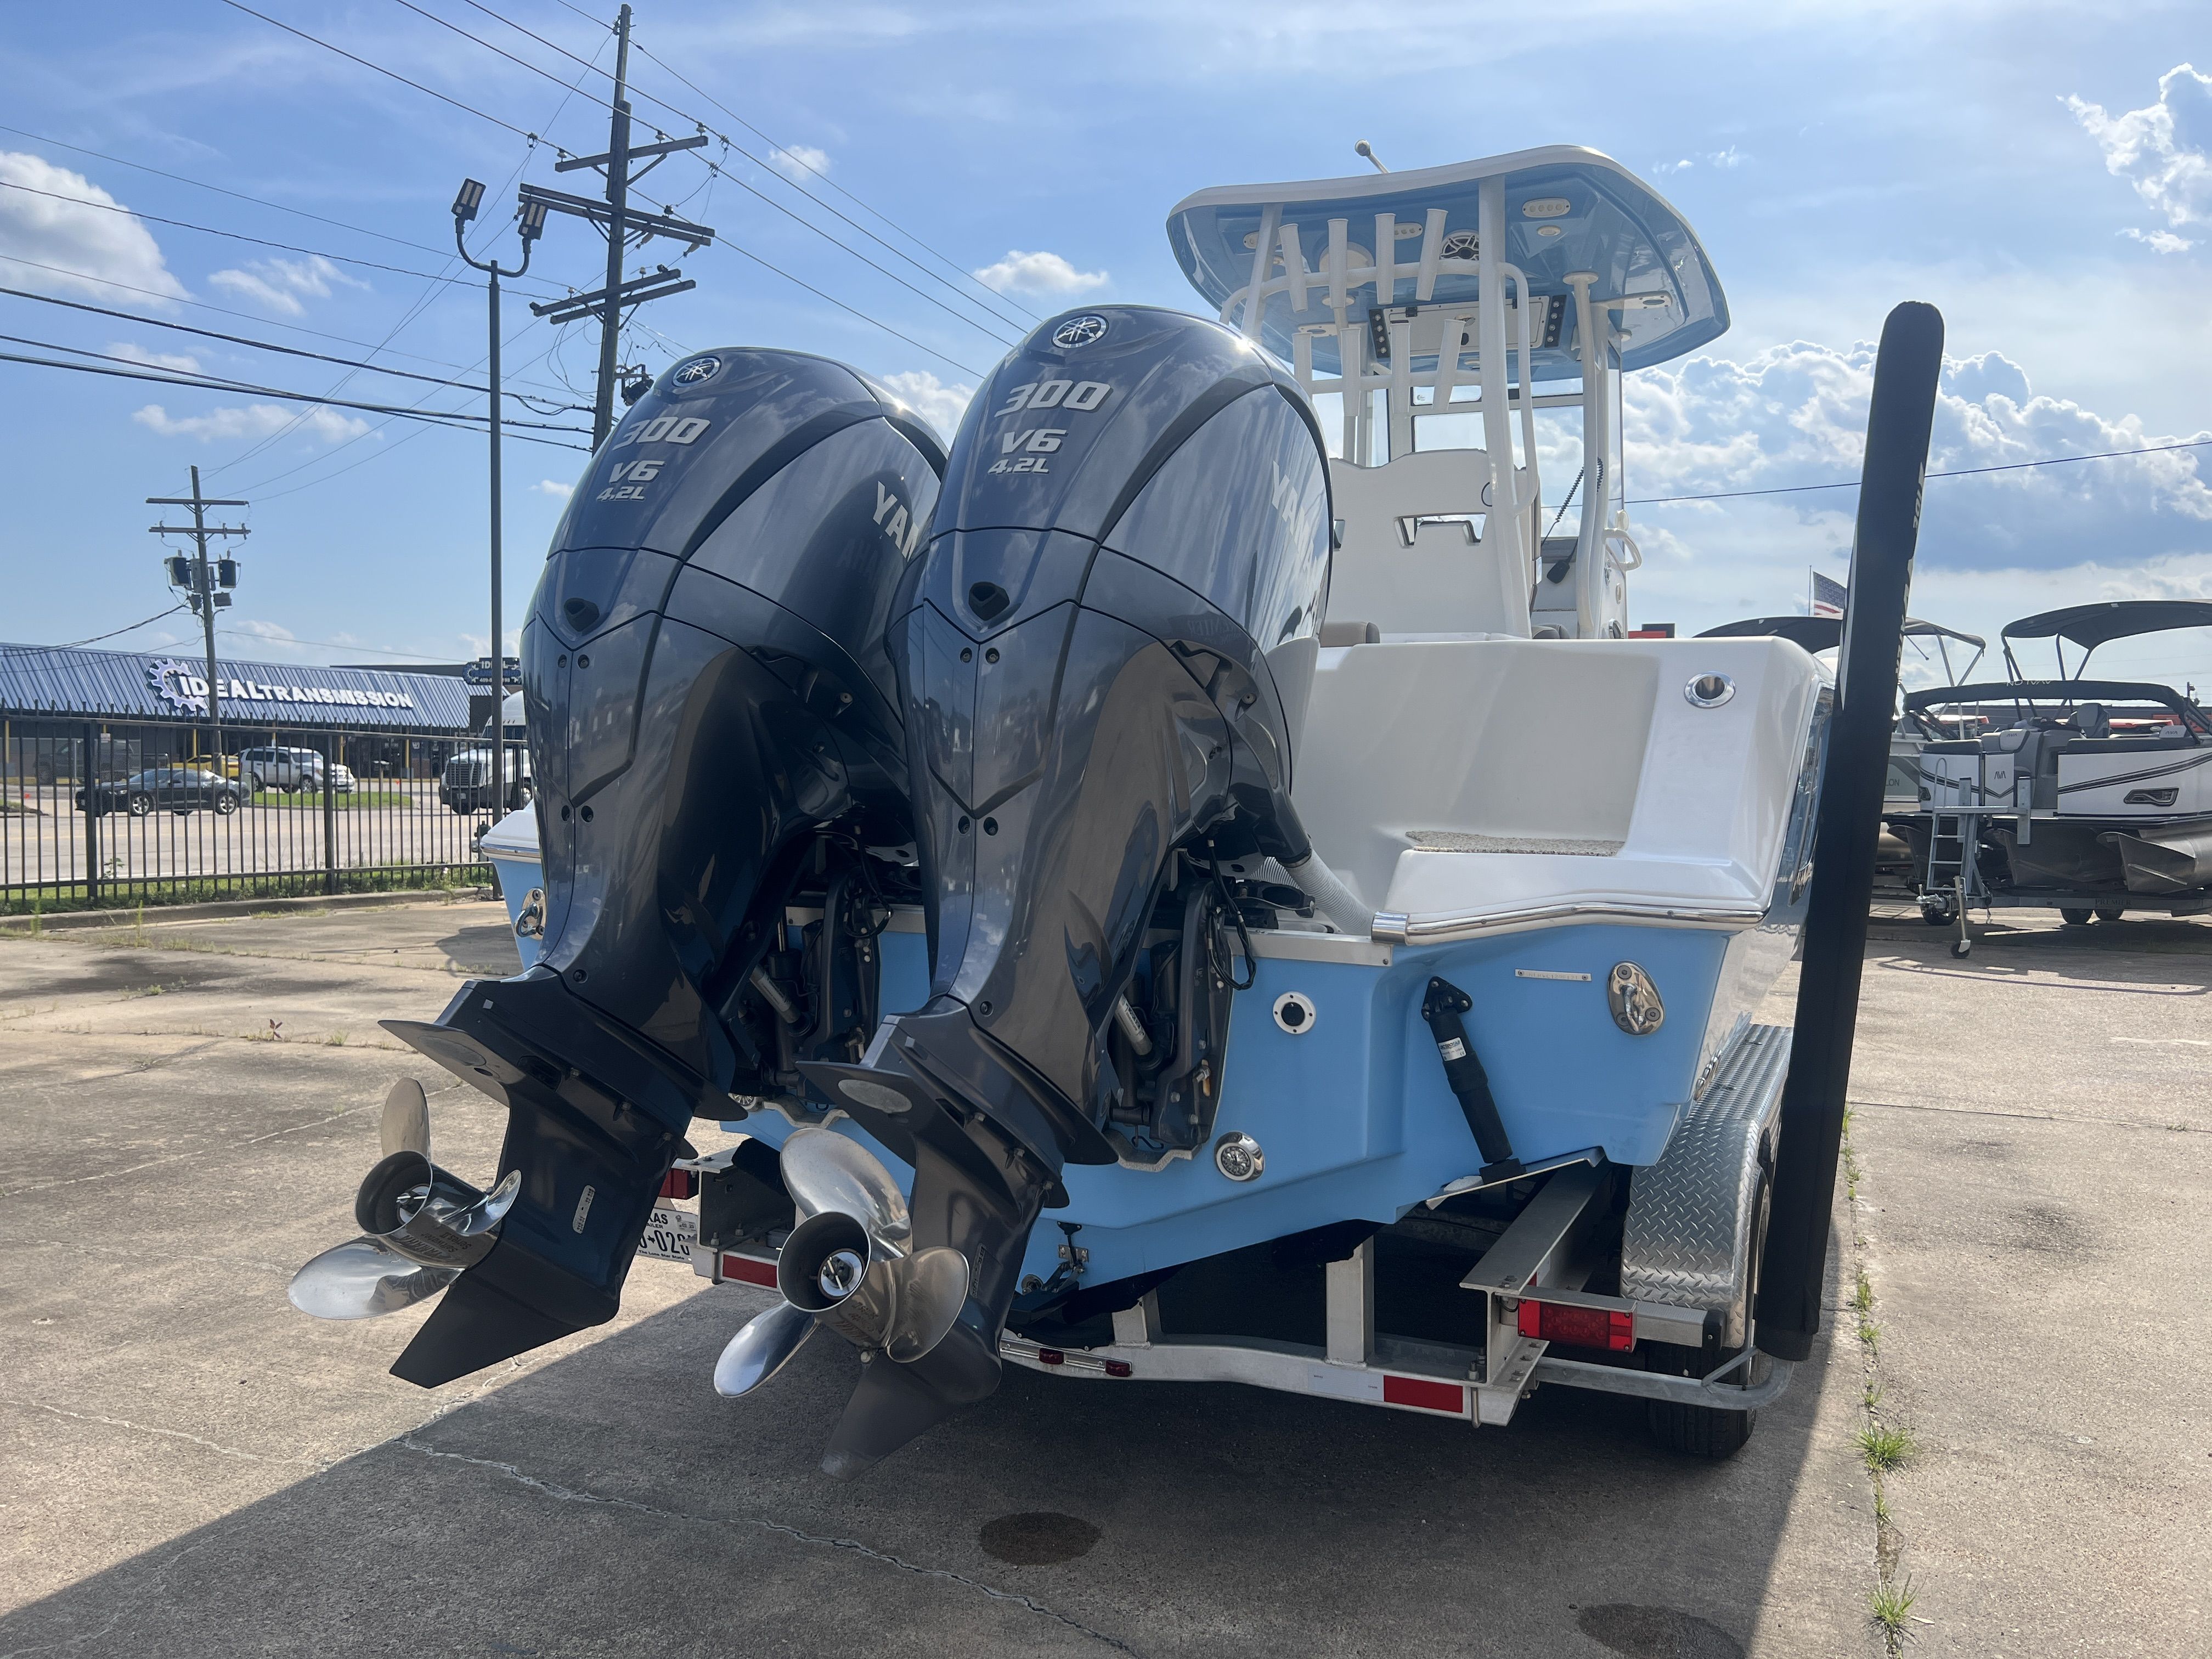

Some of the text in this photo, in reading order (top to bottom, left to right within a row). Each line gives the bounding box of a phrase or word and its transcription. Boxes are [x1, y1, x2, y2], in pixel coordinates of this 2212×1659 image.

[994, 380, 1111, 417] 300
[612, 416, 711, 450] 300
[1002, 428, 1068, 454] V6
[609, 460, 665, 483] V6
[988, 458, 1049, 474] 4.2L
[596, 486, 645, 501] 4.2L
